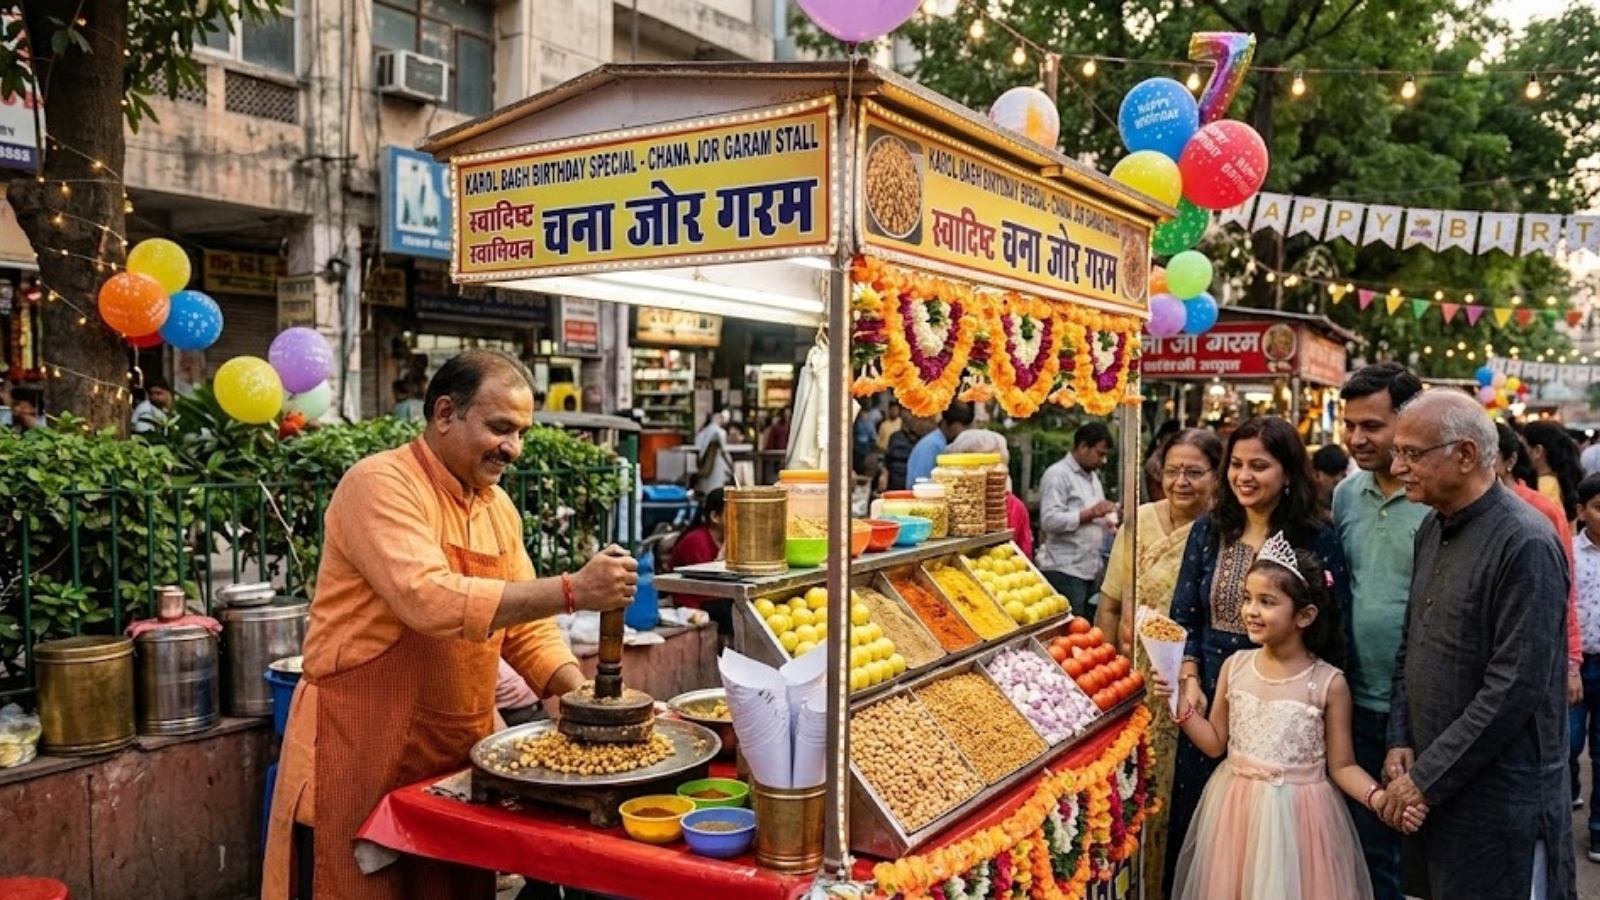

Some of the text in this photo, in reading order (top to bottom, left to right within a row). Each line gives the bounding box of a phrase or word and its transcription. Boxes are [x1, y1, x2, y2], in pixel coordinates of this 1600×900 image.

[1188, 32, 1257, 125] 7
[465, 171, 498, 195] KAROL
[501, 166, 530, 190] BAGH
[533, 157, 586, 186] BIRTHDAY
[589, 150, 637, 179] SPECIAL
[648, 142, 691, 170] CHANA
[695, 137, 720, 164] JOR
[724, 130, 772, 160] GARAM
[776, 123, 818, 153] STALL
[541, 178, 818, 255] चना जोर गरम
[1449, 218, 1594, 243] BIRT
[1001, 220, 1042, 274] चना
[1047, 222, 1081, 284] जोर
[1085, 247, 1118, 294] गरम
